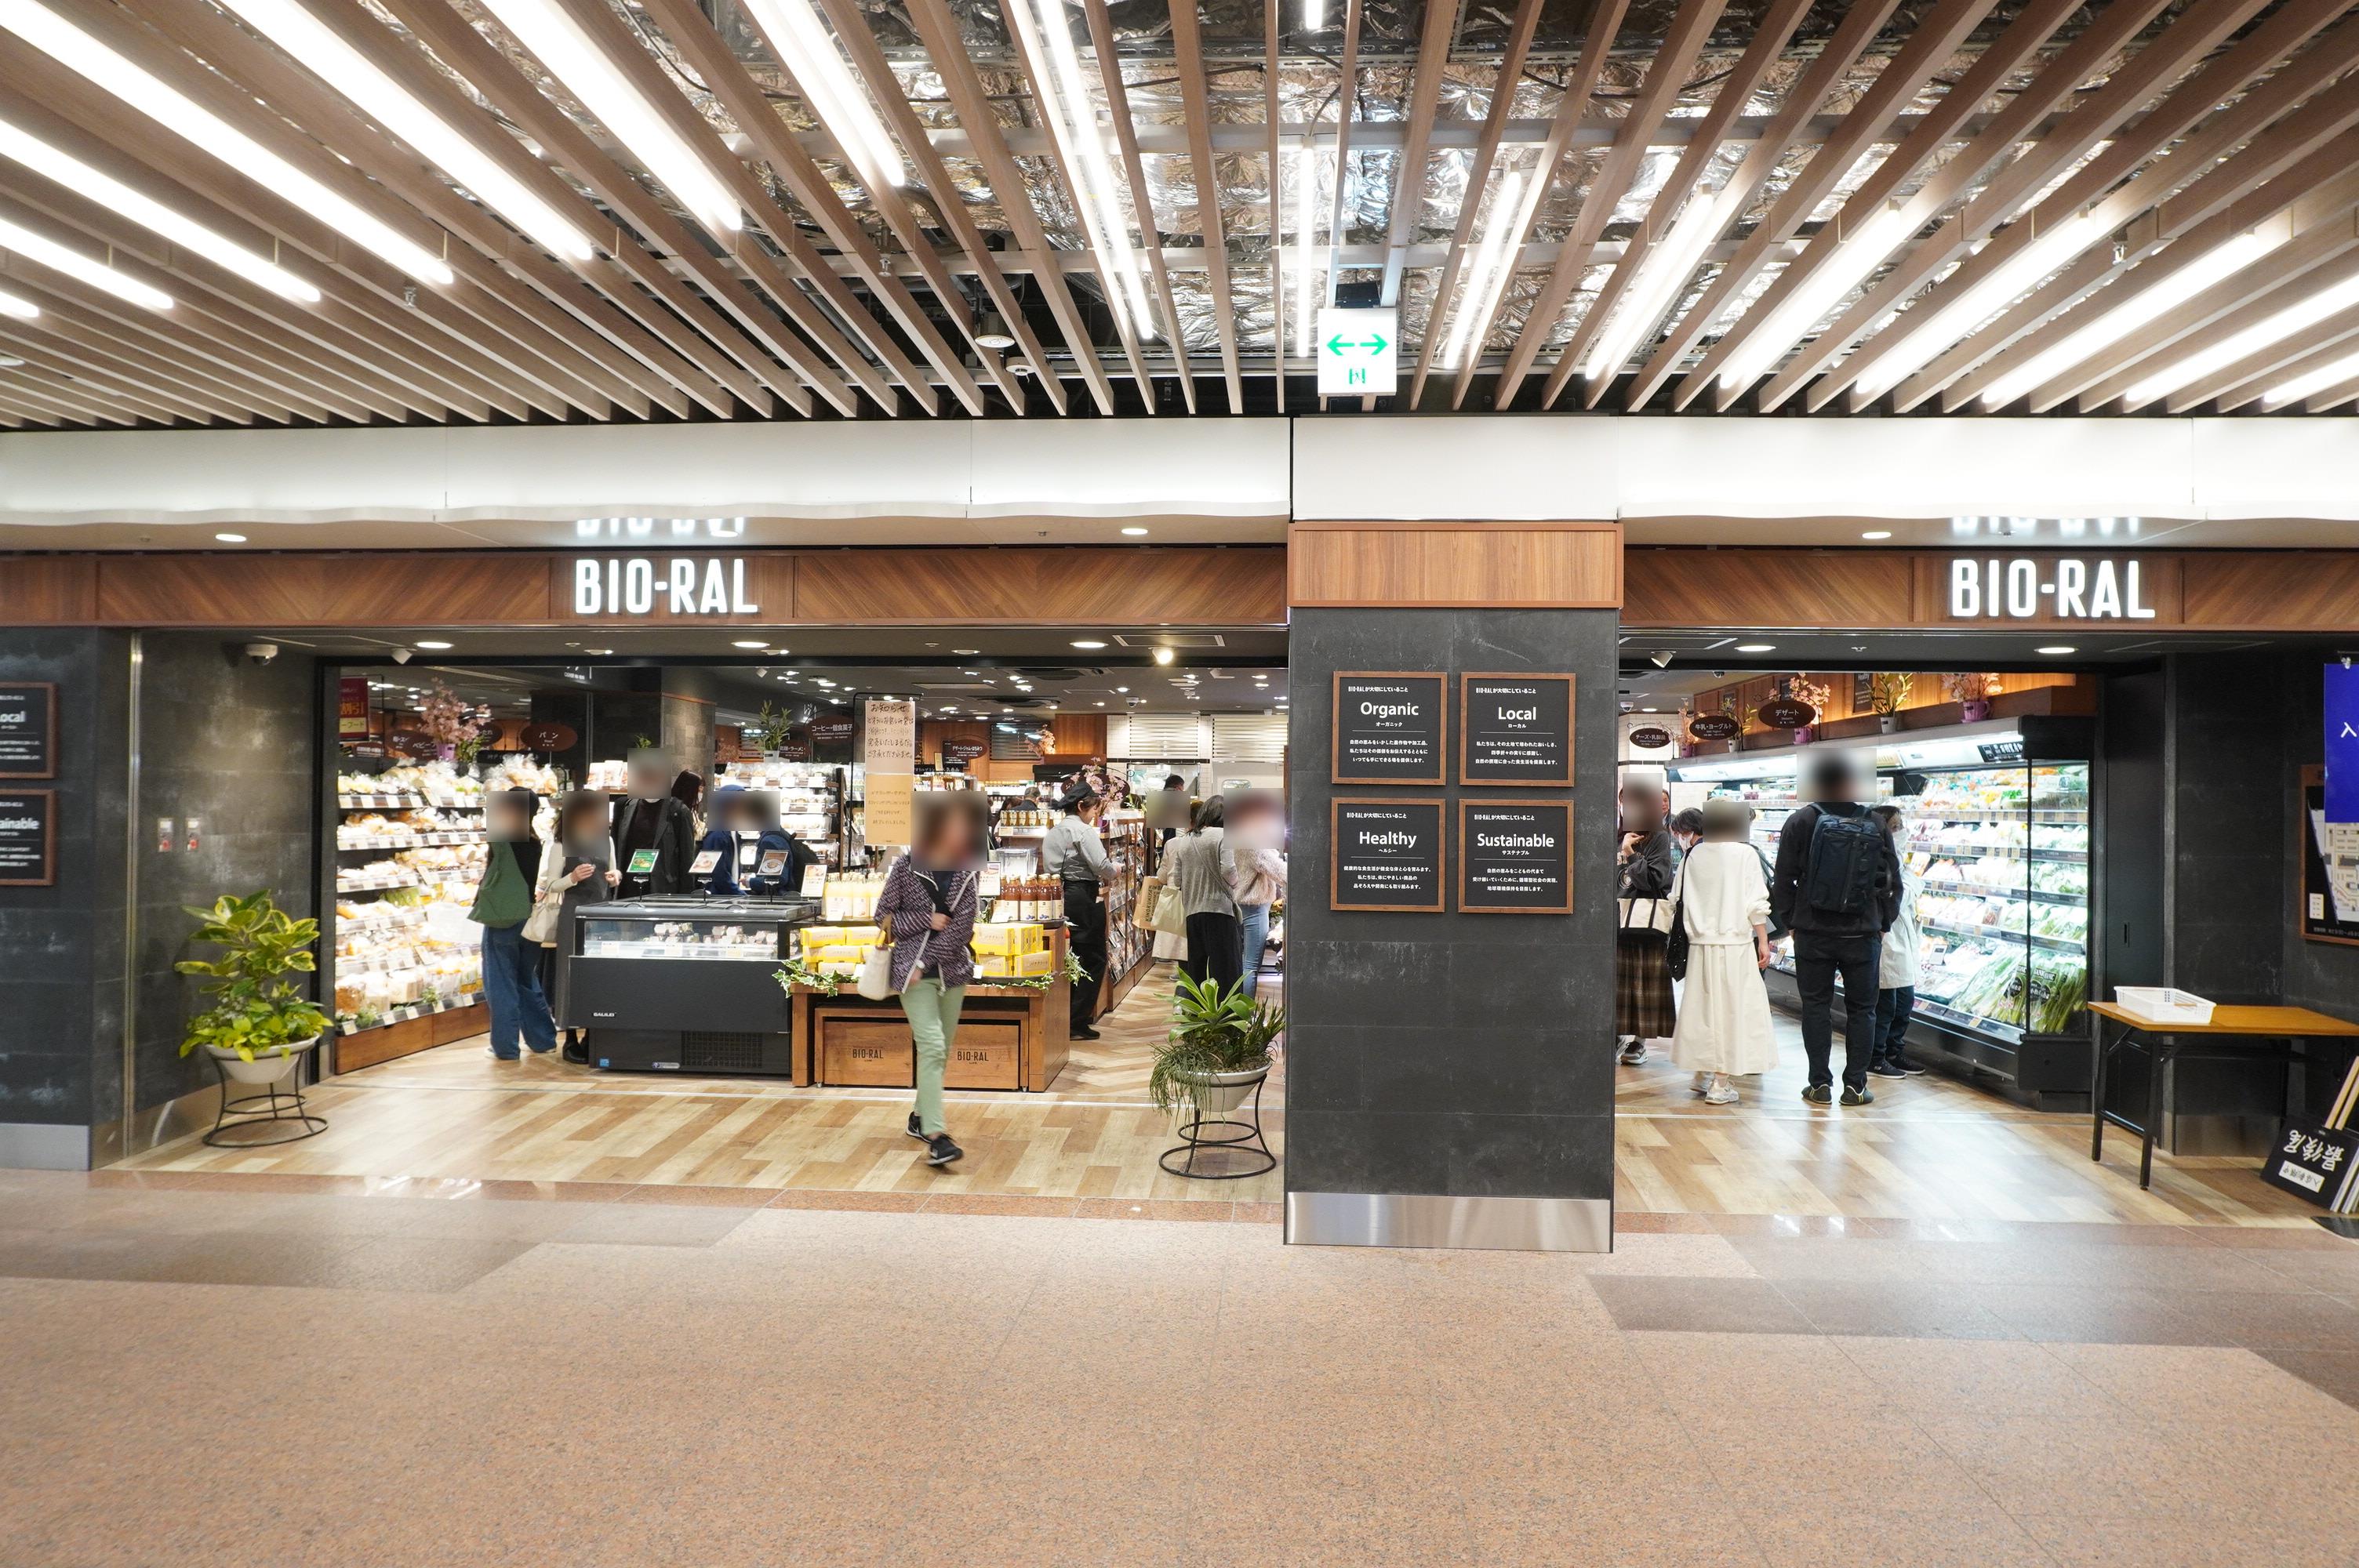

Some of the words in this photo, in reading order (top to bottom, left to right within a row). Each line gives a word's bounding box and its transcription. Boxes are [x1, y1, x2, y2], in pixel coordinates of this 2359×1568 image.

[576, 559, 758, 614] BIO-RAL
[1952, 559, 2156, 619] BIO-RAL
[0, 711, 26, 722] ocal
[1360, 702, 1419, 718] Organic
[1498, 706, 1537, 720] Local
[1359, 831, 1417, 848] Healthy
[1477, 833, 1555, 848] Sustainable
[852, 1049, 884, 1059] BIO-RAL
[958, 1051, 989, 1062] BIO-RAL
[2283, 1130, 2345, 1172] 最後尾
